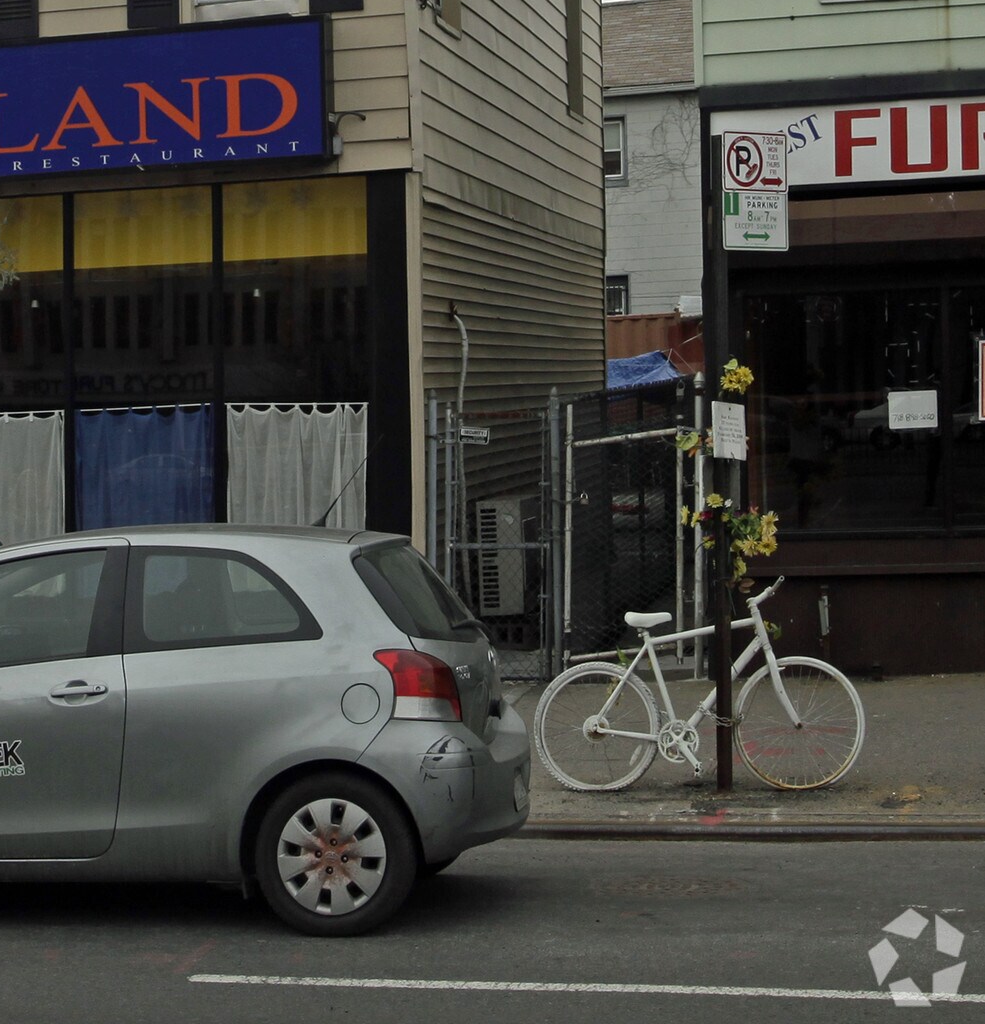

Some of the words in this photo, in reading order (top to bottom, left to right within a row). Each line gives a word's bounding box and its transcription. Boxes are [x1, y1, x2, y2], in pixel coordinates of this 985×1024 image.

[782, 114, 822, 153] ST
[12, 140, 300, 172] RESTAURANT
[747, 201, 778, 209] PARKING
